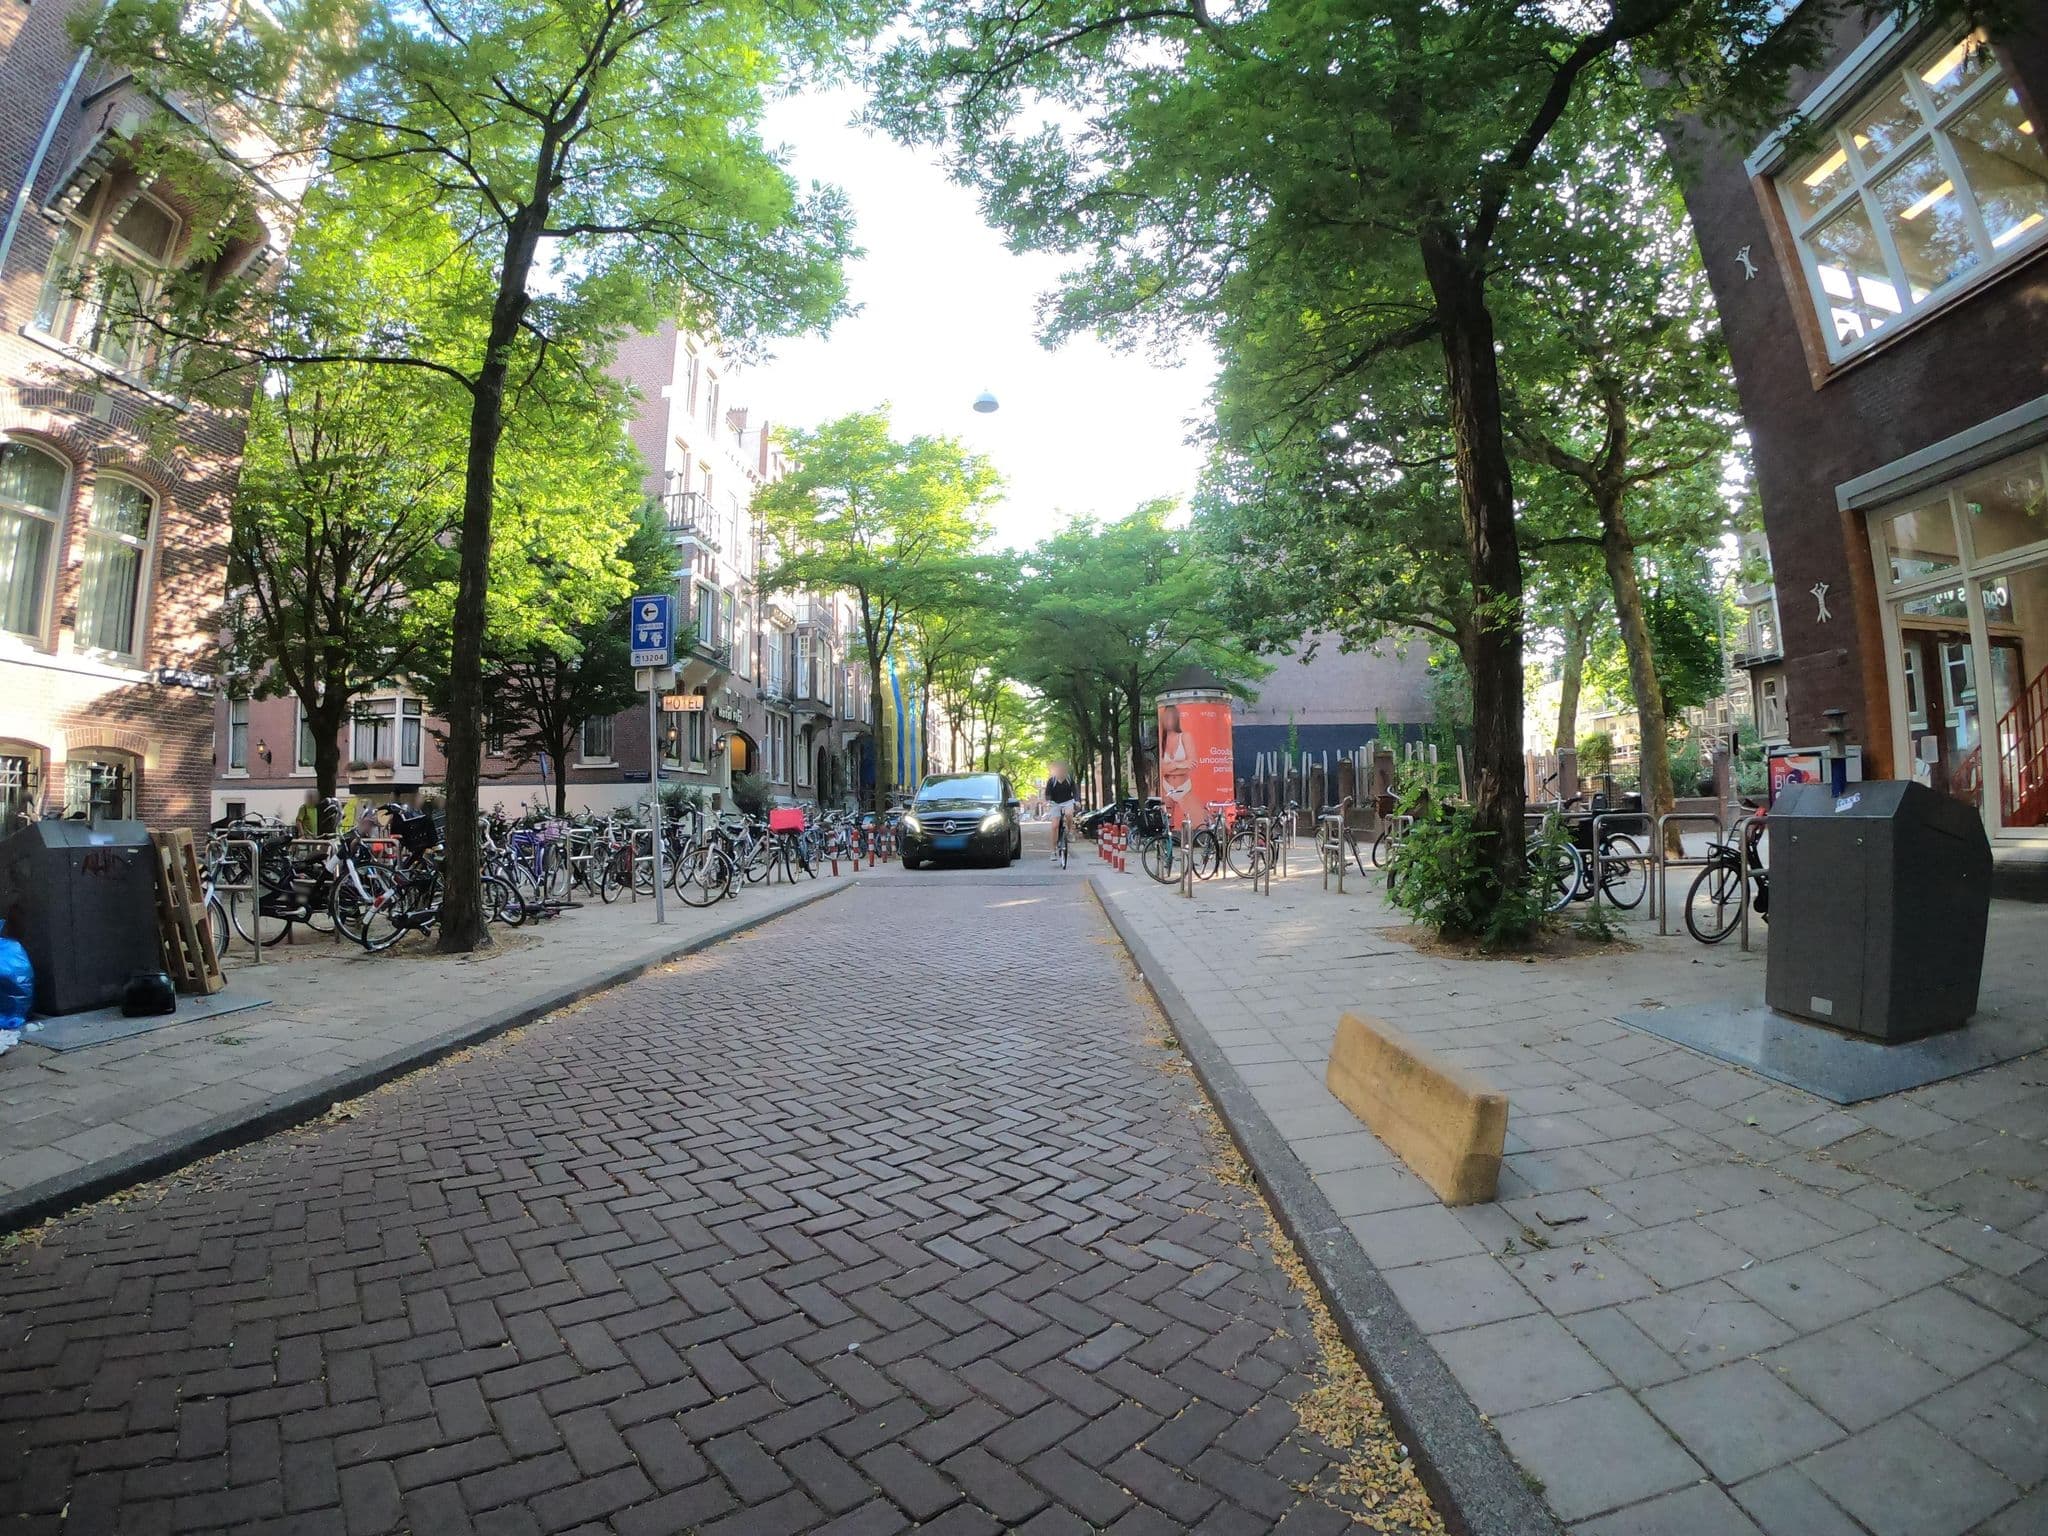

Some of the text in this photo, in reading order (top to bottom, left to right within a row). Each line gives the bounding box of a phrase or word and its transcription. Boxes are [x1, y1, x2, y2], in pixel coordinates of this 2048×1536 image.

[642, 654, 664, 662] 13204
[665, 698, 702, 710] HOTEL
[1775, 774, 1797, 790] BIG
